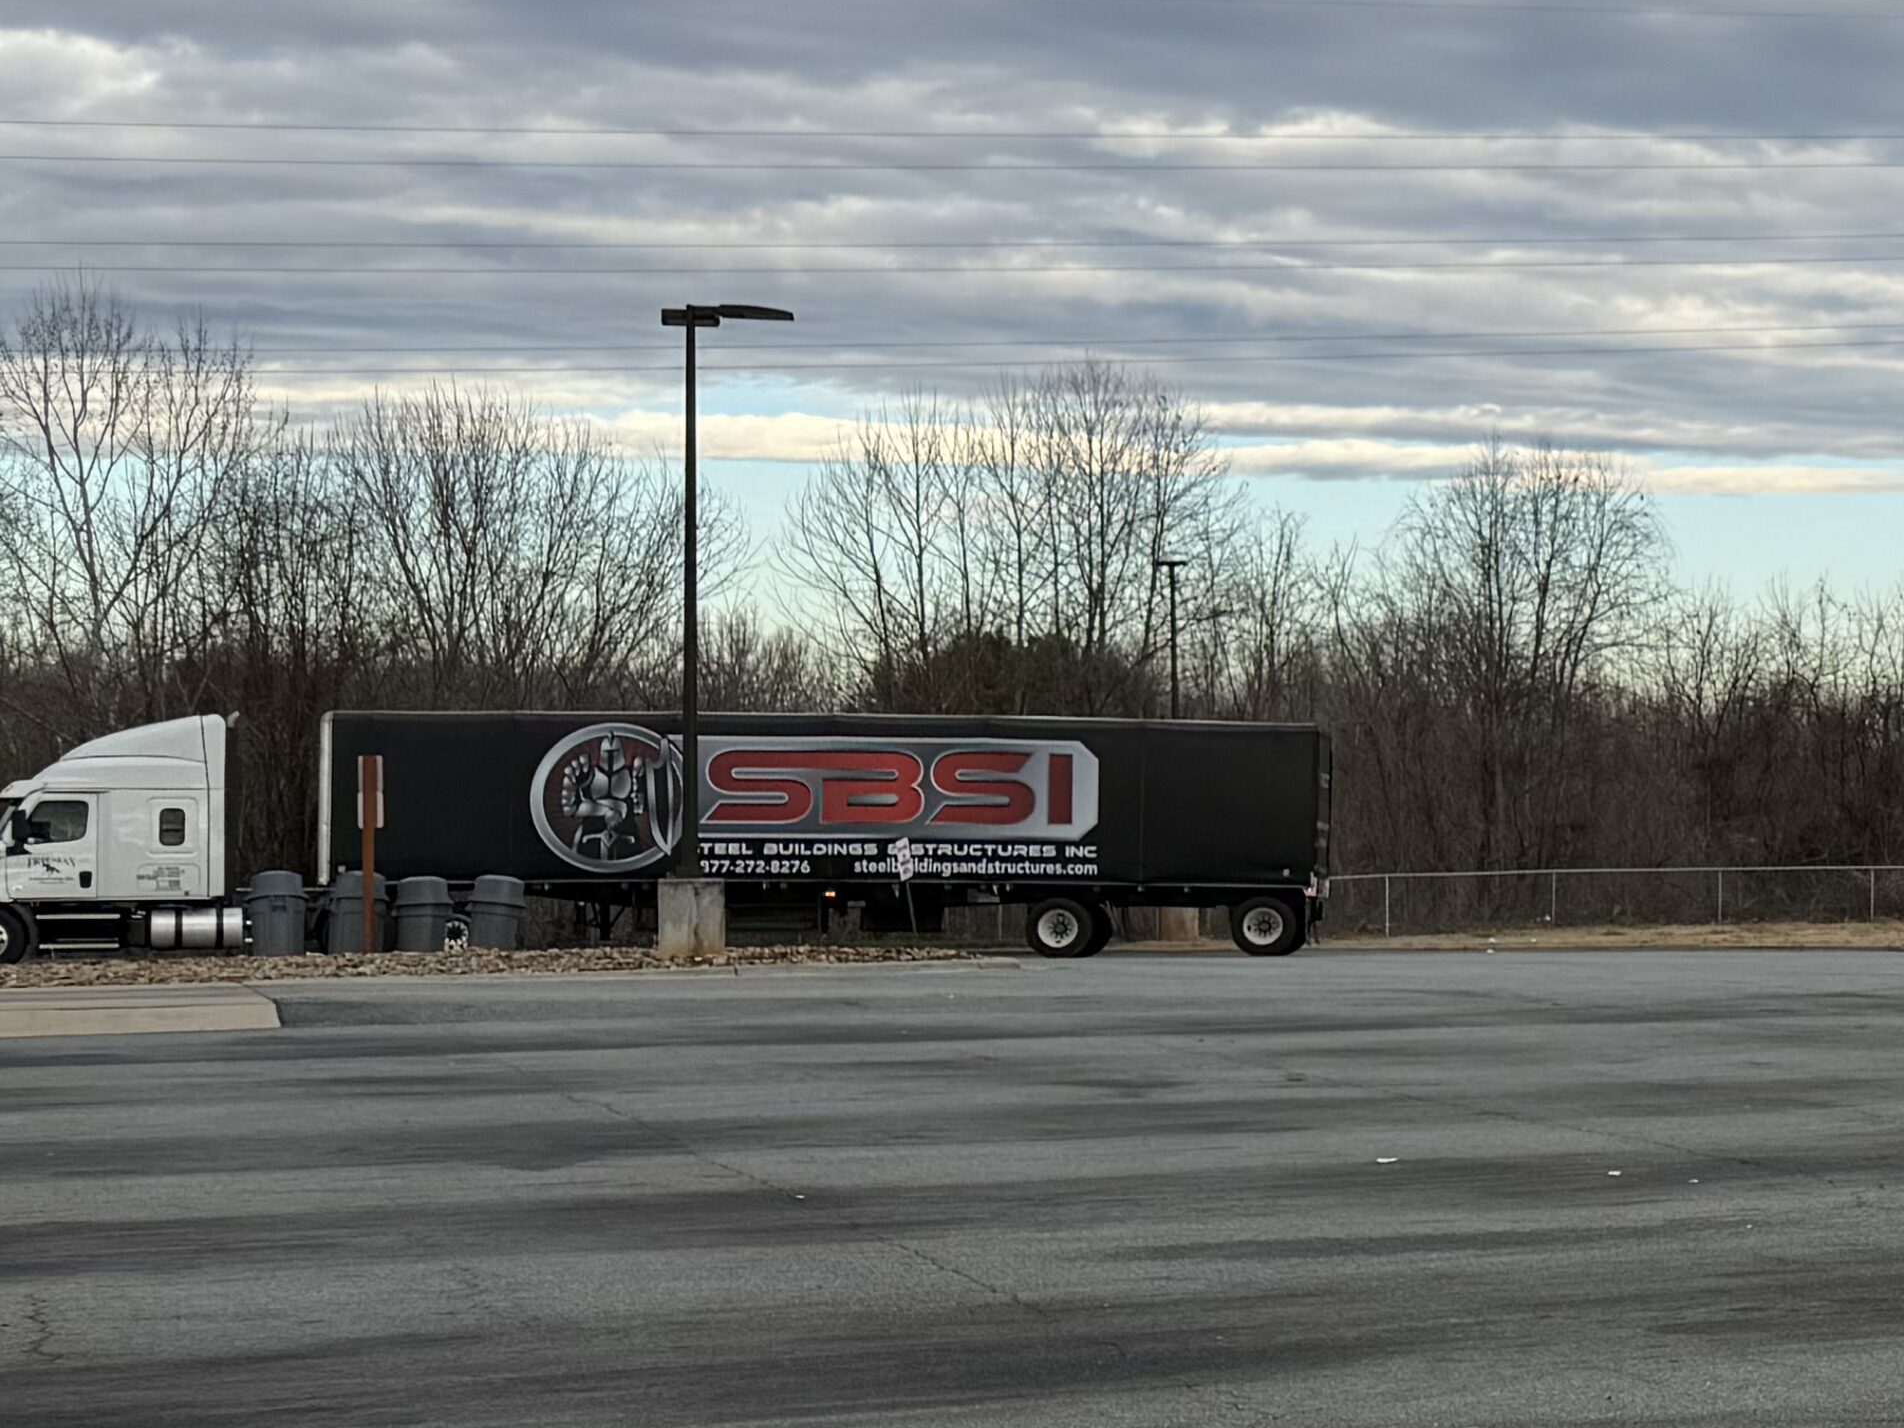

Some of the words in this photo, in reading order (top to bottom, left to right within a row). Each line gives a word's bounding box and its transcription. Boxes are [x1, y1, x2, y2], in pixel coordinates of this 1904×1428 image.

[702, 748, 1074, 827] SBSI
[697, 843, 753, 855] TEEL
[763, 843, 878, 855] BUILDINGS
[911, 843, 1057, 857] STRUCTURES
[1065, 845, 1097, 858] INC
[854, 857, 1098, 877] steelbldingsandstructures.com
